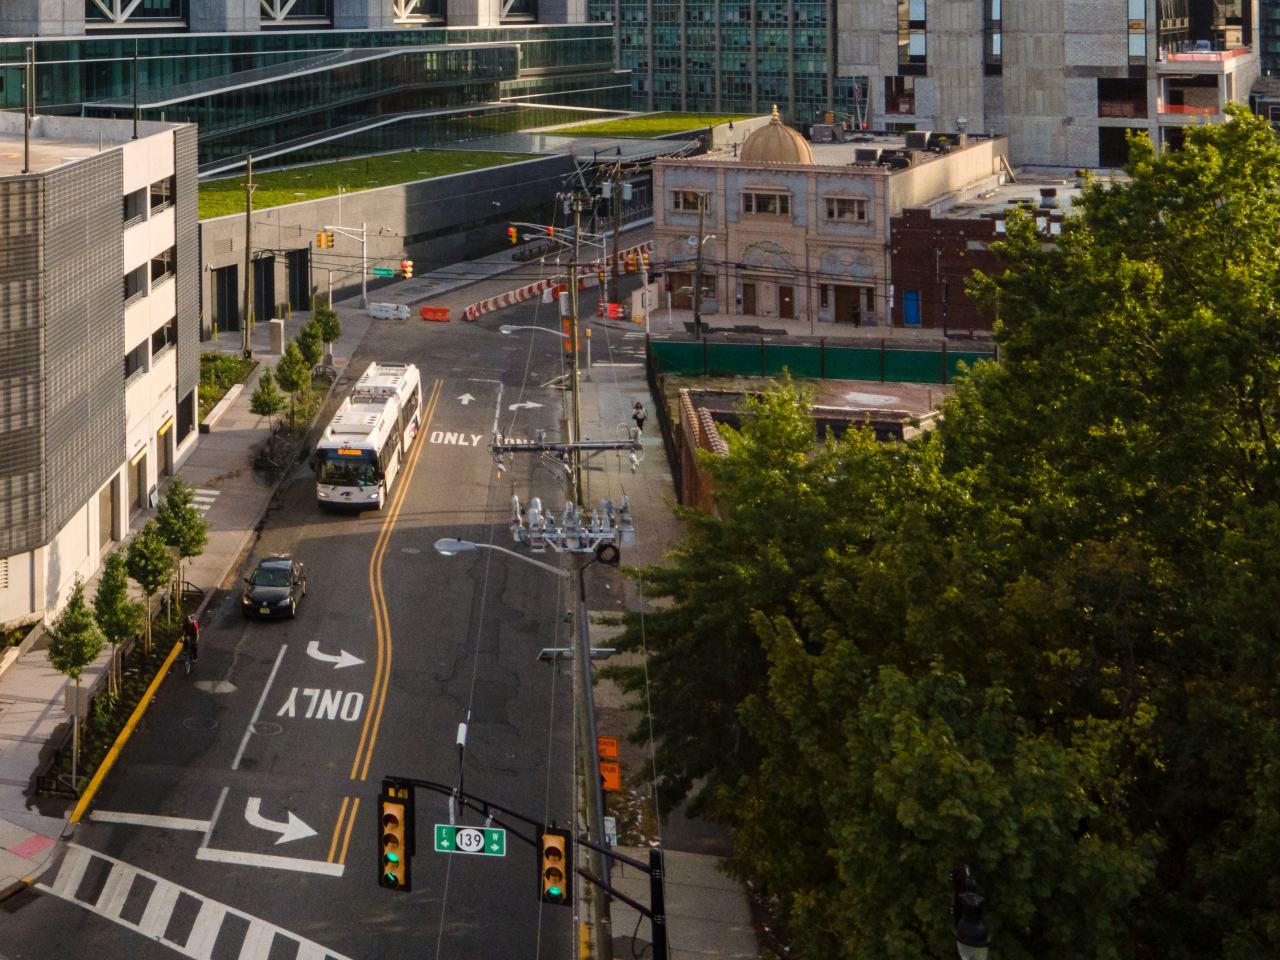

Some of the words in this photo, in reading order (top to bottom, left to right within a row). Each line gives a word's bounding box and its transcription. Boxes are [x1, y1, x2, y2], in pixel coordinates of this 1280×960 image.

[429, 431, 482, 447] ONLY
[276, 687, 364, 722] ONLY
[442, 828, 448, 837] E
[459, 833, 482, 847] 139
[492, 832, 499, 841] W
